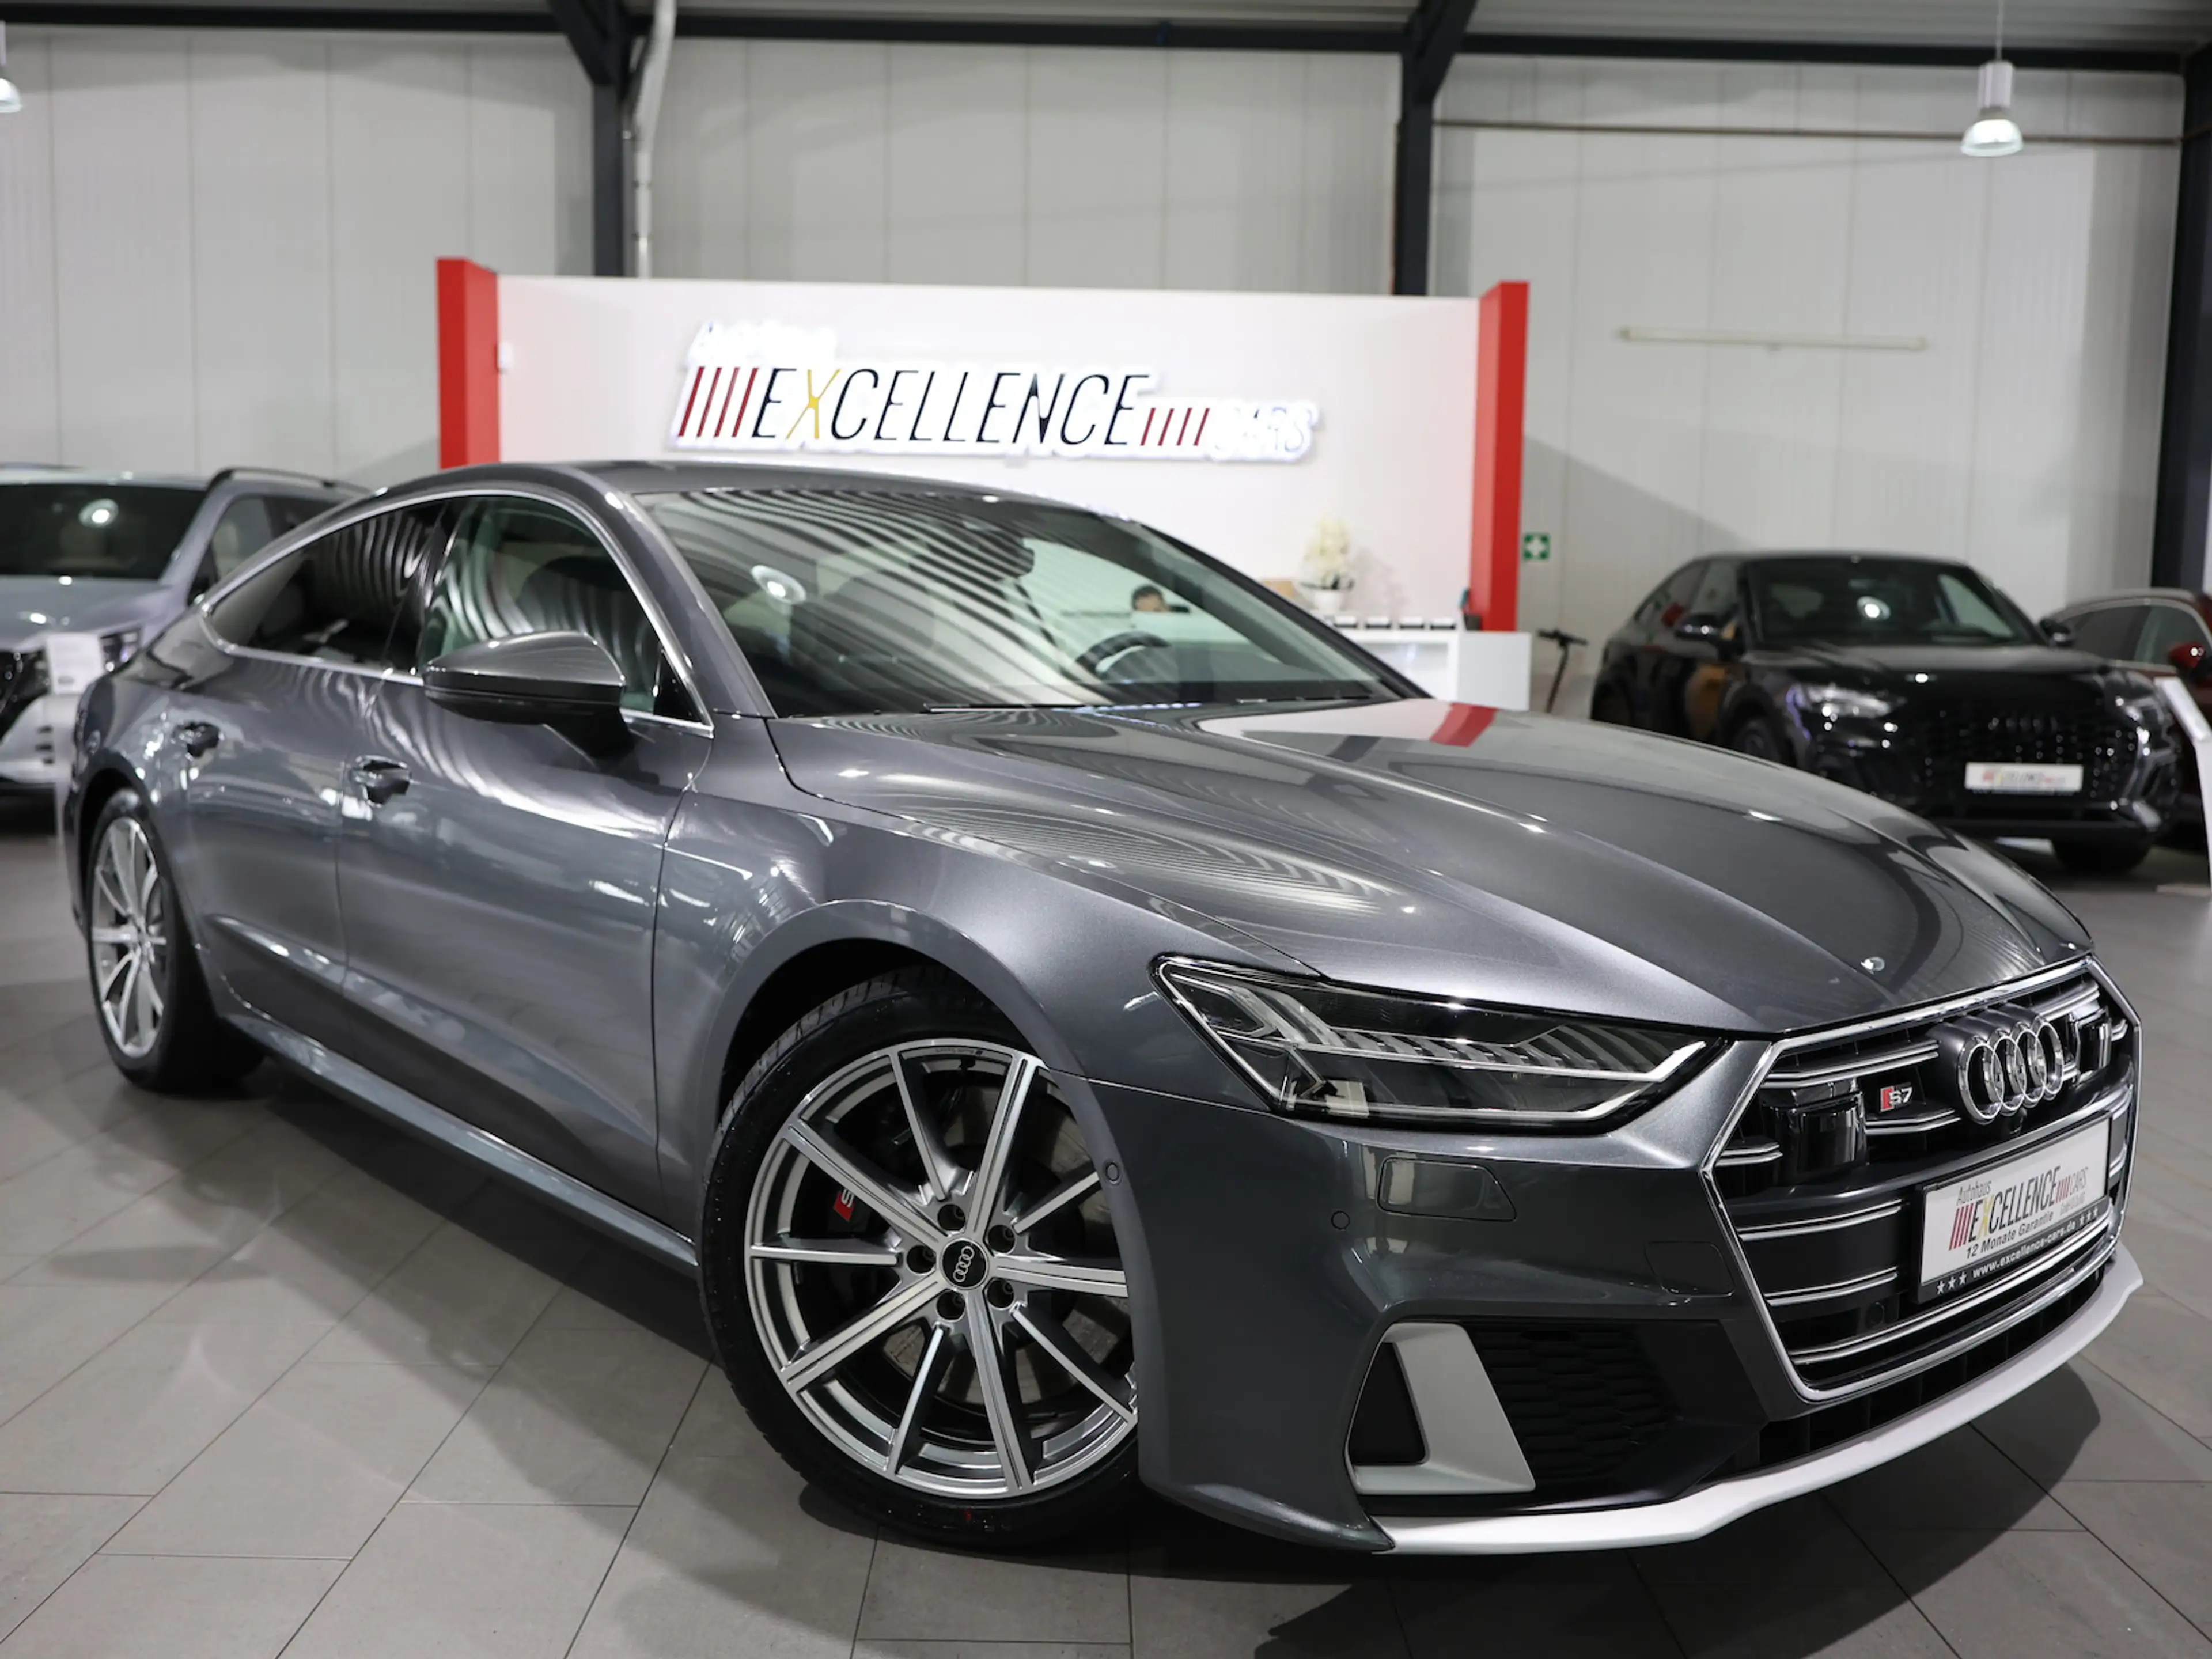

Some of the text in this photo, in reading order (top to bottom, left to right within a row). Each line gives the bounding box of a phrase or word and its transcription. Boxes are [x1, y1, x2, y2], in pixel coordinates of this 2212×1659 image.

[751, 366, 1150, 445] EXCELLENCE
[1888, 1086, 1913, 1105] S7
[1968, 1165, 2061, 1243] EXCELLENCE
[1967, 1210, 2054, 1259] 12 Monate Garantie
[1972, 1220, 2076, 1279] www.excellence-cars.de
